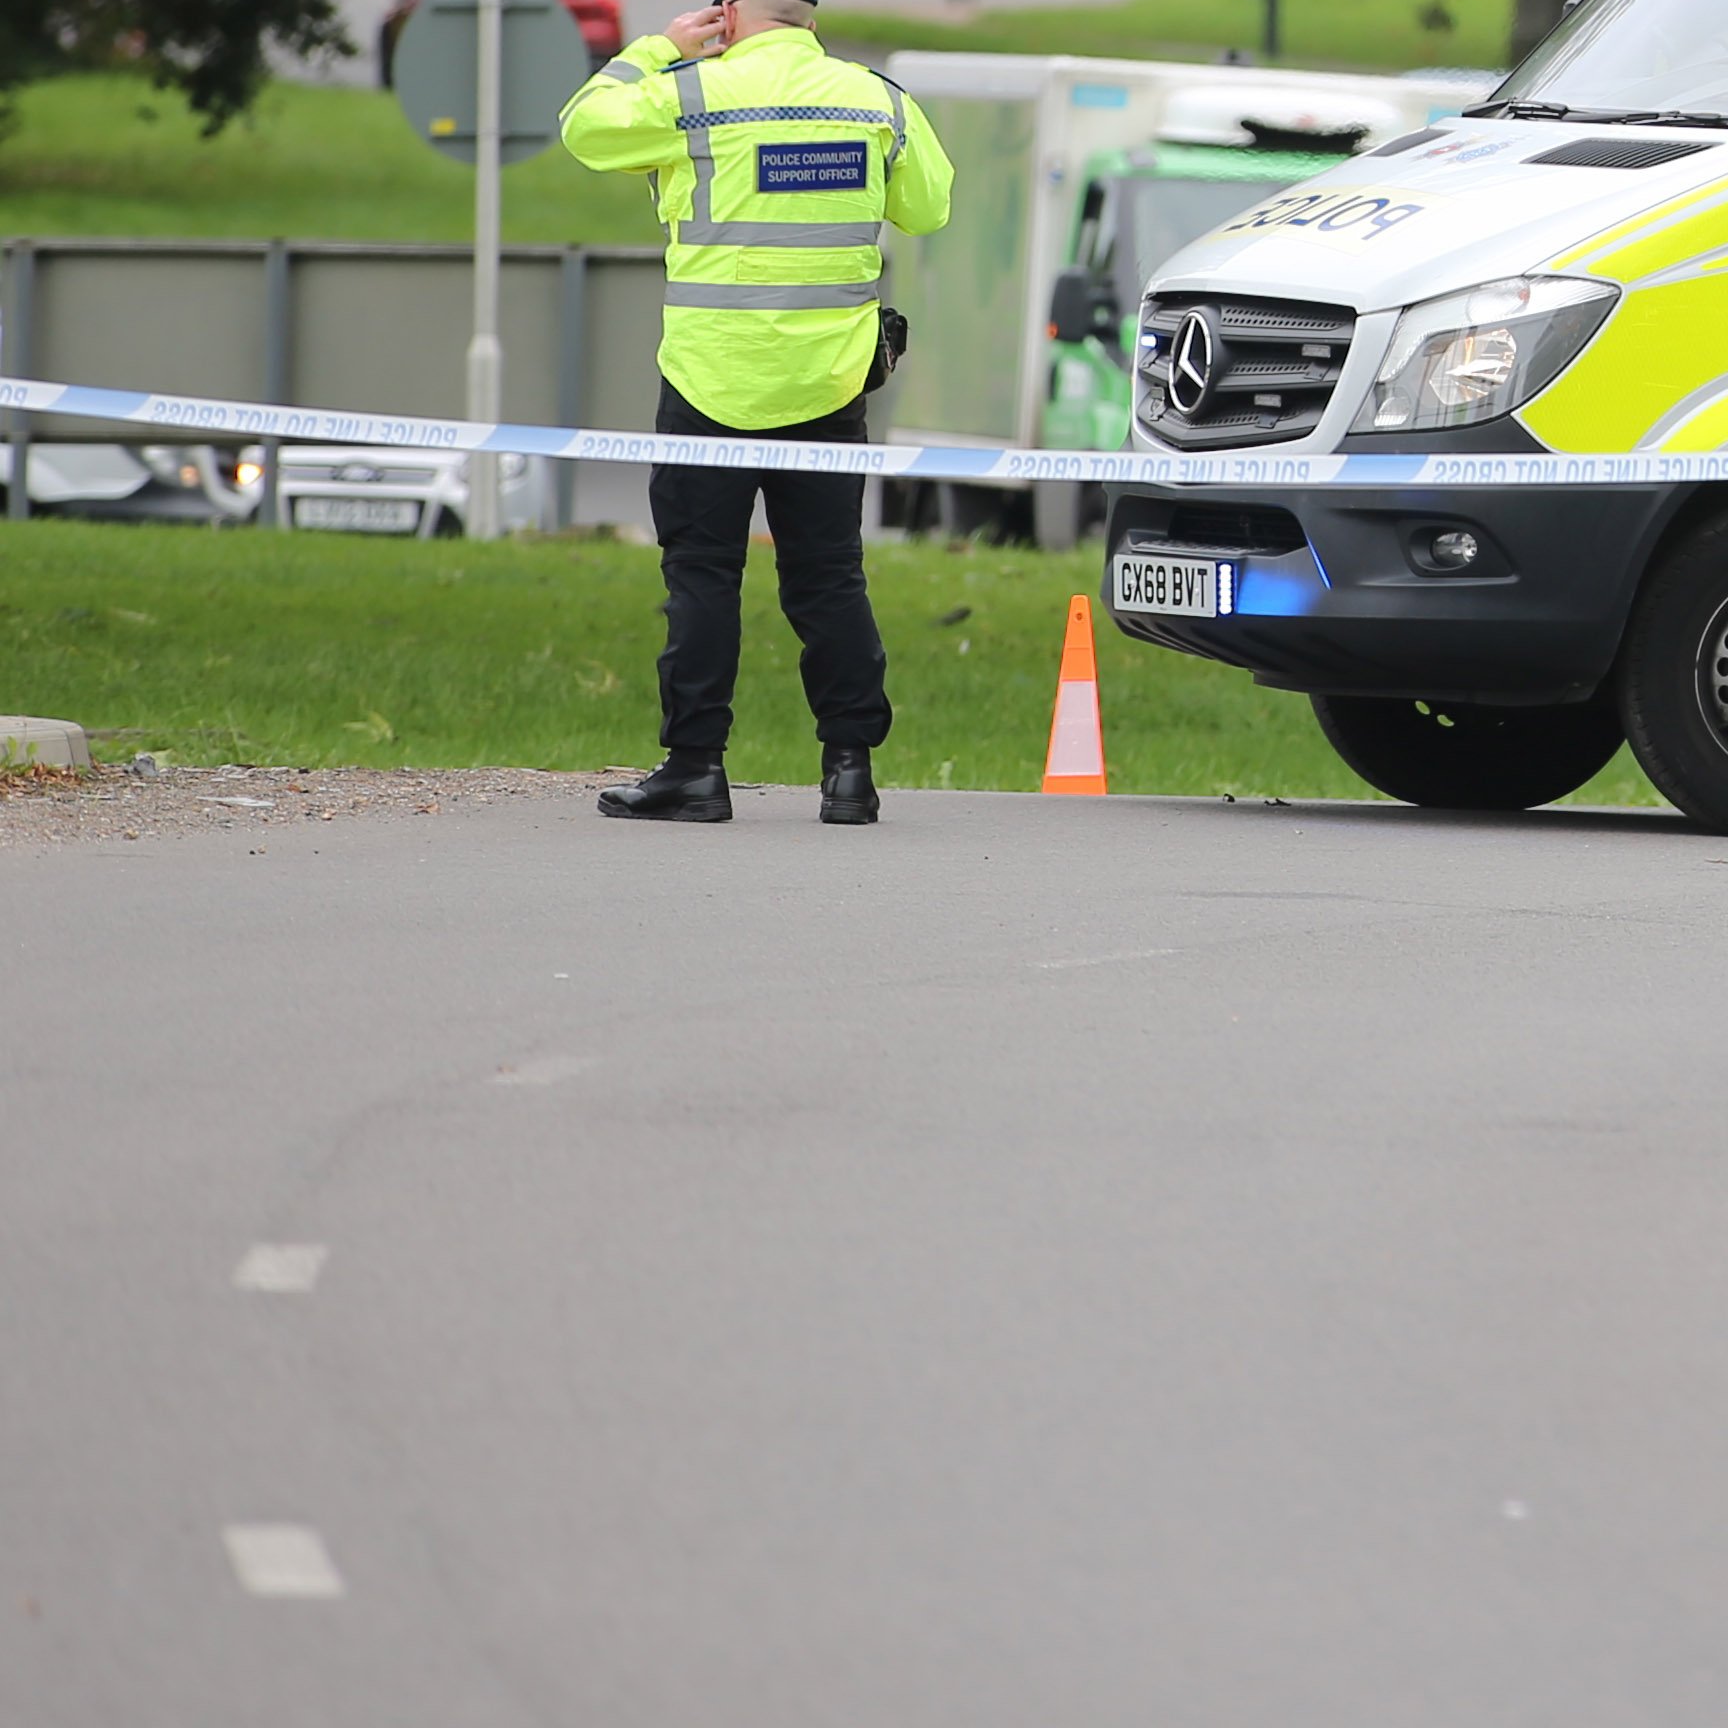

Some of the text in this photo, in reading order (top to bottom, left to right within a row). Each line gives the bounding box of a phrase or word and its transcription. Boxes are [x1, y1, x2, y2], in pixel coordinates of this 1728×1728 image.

[762, 151, 863, 166] POLICE COMMUNITY
[768, 168, 859, 182] SUPPORT OFFICER
[1122, 562, 1208, 608] GX68 BVT
